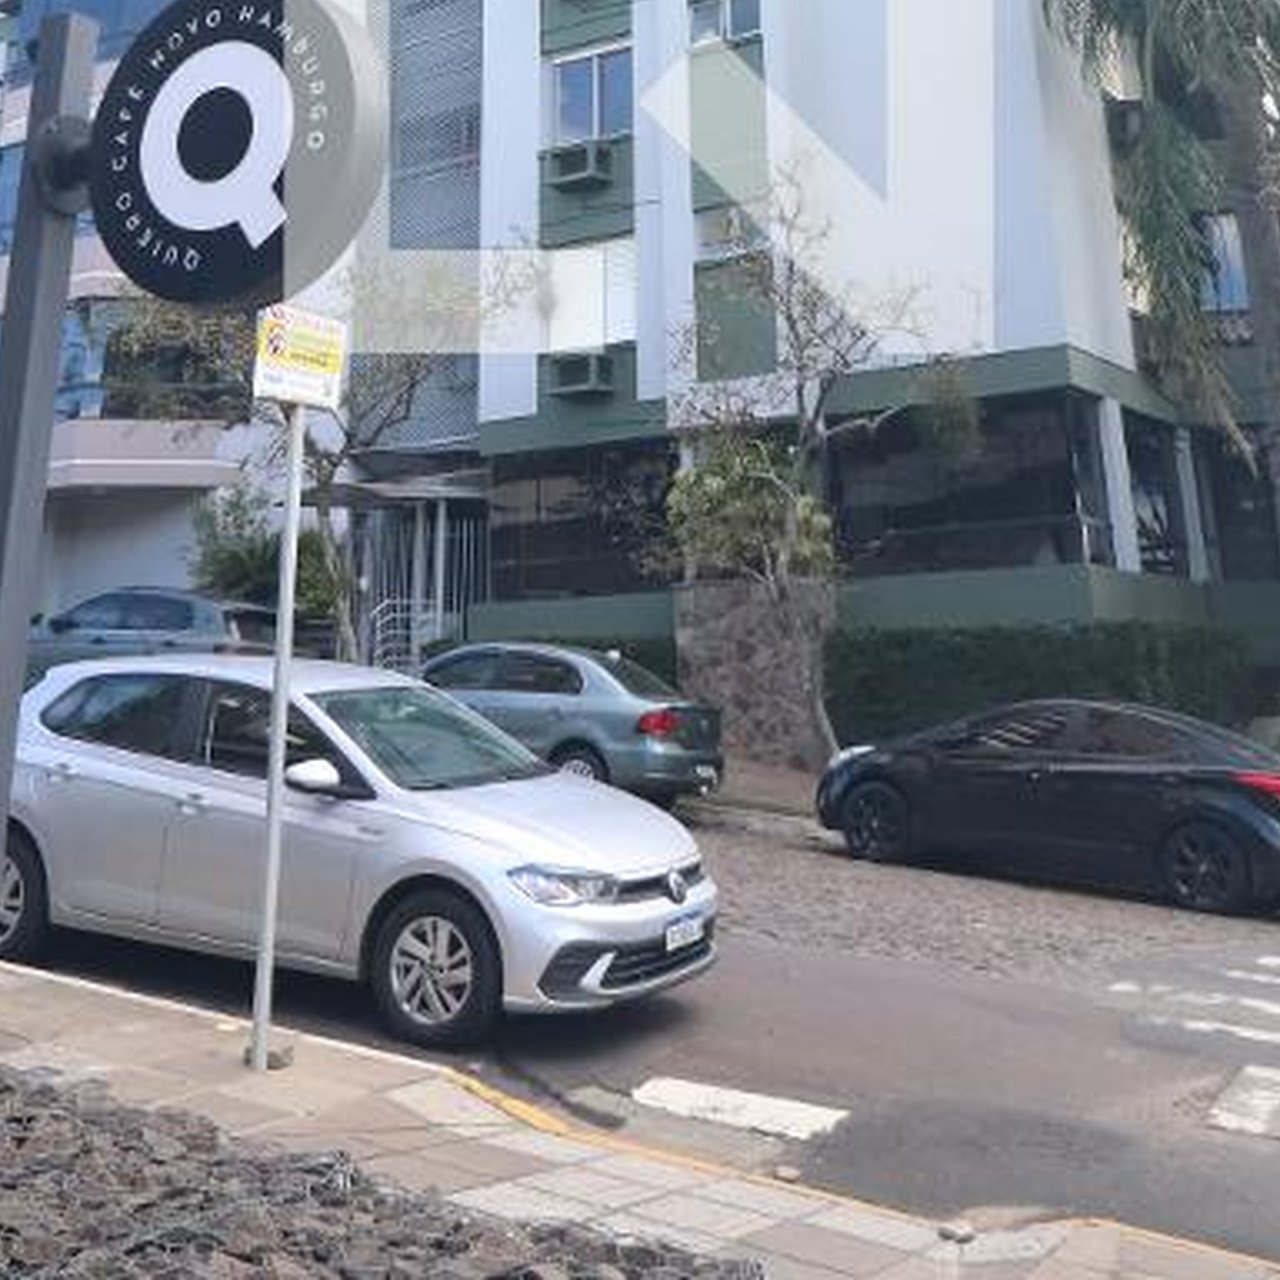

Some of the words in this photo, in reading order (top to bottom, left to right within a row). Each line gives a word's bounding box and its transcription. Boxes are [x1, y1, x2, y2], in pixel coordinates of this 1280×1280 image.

[139, 40, 295, 250] Q
[148, 8, 221, 70] NOVO
[238, 5, 328, 150] HAMBURGO
